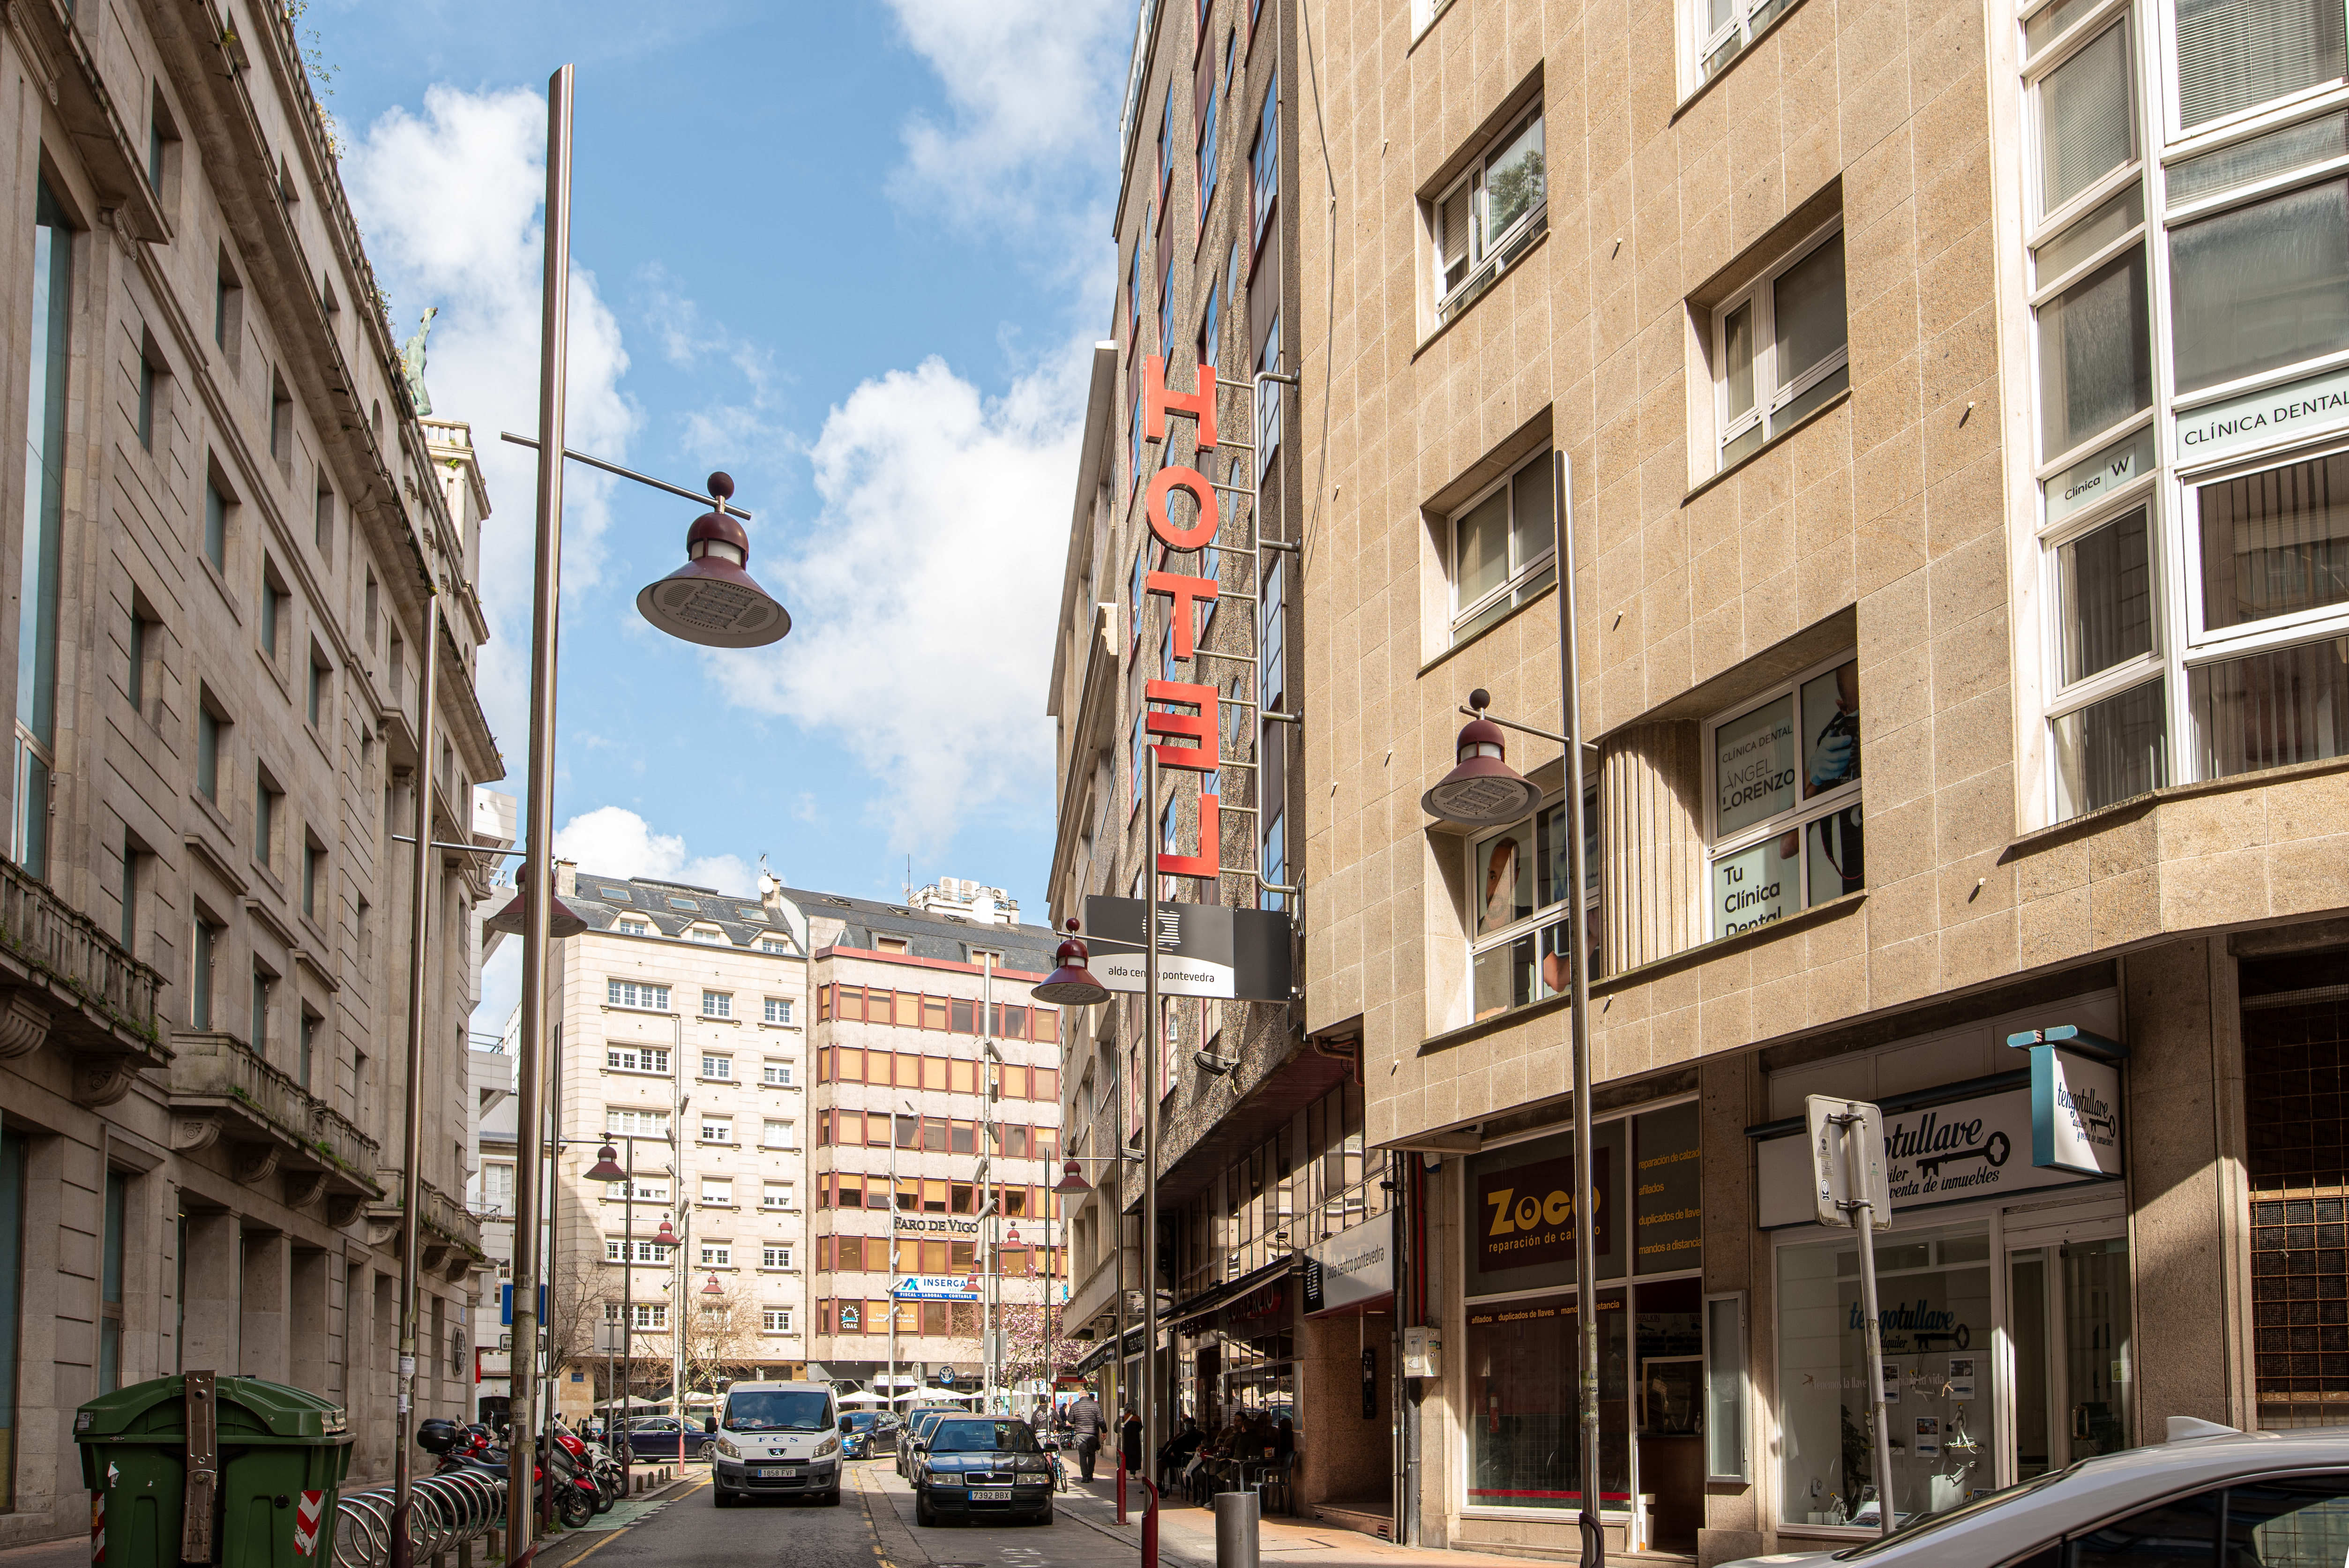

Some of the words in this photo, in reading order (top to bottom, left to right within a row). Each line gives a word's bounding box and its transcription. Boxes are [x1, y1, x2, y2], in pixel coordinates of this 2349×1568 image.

[2184, 413, 2267, 445] CLÍNICA
[2274, 392, 2349, 423] DENTAL
[2065, 475, 2101, 500] Clínica
[2111, 456, 2130, 477] W
[1722, 739, 1757, 763] CLÍNICA
[1758, 725, 1792, 747] DENTAL
[1723, 758, 1773, 792] ÁNGEL
[1723, 768, 1795, 812] LORENZO
[1723, 865, 1743, 886] Tu
[1724, 881, 1780, 914] Clínica
[1108, 965, 1128, 977] alda
[1130, 969, 1160, 978] cen
[1163, 971, 1214, 983] pontevedra
[2058, 1082, 2108, 1118] tengotullave
[2073, 1115, 2087, 1130] alquiler
[1884, 1112, 1983, 1159] otullave
[2077, 1131, 2080, 1142] y
[2081, 1131, 2090, 1141] venta
[2091, 1130, 2096, 1142] de
[2097, 1135, 2113, 1147] inmuebles
[1639, 1154, 1669, 1170] reparación
[1671, 1152, 1678, 1162] de
[1887, 1165, 1909, 1183] uiler
[1890, 1180, 1919, 1198] venta
[1923, 1176, 1938, 1193] de
[1941, 1165, 2000, 1191] inmuebles
[1639, 1183, 1664, 1195] afilados
[894, 1217, 926, 1231] FARO
[929, 1220, 946, 1231] DE
[948, 1219, 979, 1232] VIGO
[1639, 1211, 1675, 1226] duplicados
[1675, 1210, 1683, 1219] de
[1685, 1208, 1700, 1217] llave
[1489, 1235, 1540, 1254] reparación
[1545, 1232, 1556, 1243] de
[1560, 1226, 1600, 1241] calo
[1639, 1242, 1665, 1254] mandos
[1672, 1237, 1701, 1250] distancia
[1327, 1262, 1337, 1280] alda
[1338, 1258, 1353, 1277] centro
[1354, 1244, 1384, 1275] pontevedra
[924, 1278, 969, 1287] INSERGA
[1472, 1315, 1492, 1324] afilados
[1498, 1313, 1528, 1322] duplicados
[1561, 1305, 1578, 1314] mand
[1596, 1300, 1620, 1310] istancia
[1849, 1299, 1955, 1337] tegotullave
[1814, 1379, 1842, 1390] Tenemos
[1844, 1377, 1849, 1389] la
[1852, 1377, 1867, 1388] llave
[1929, 1373, 1944, 1384] vida
